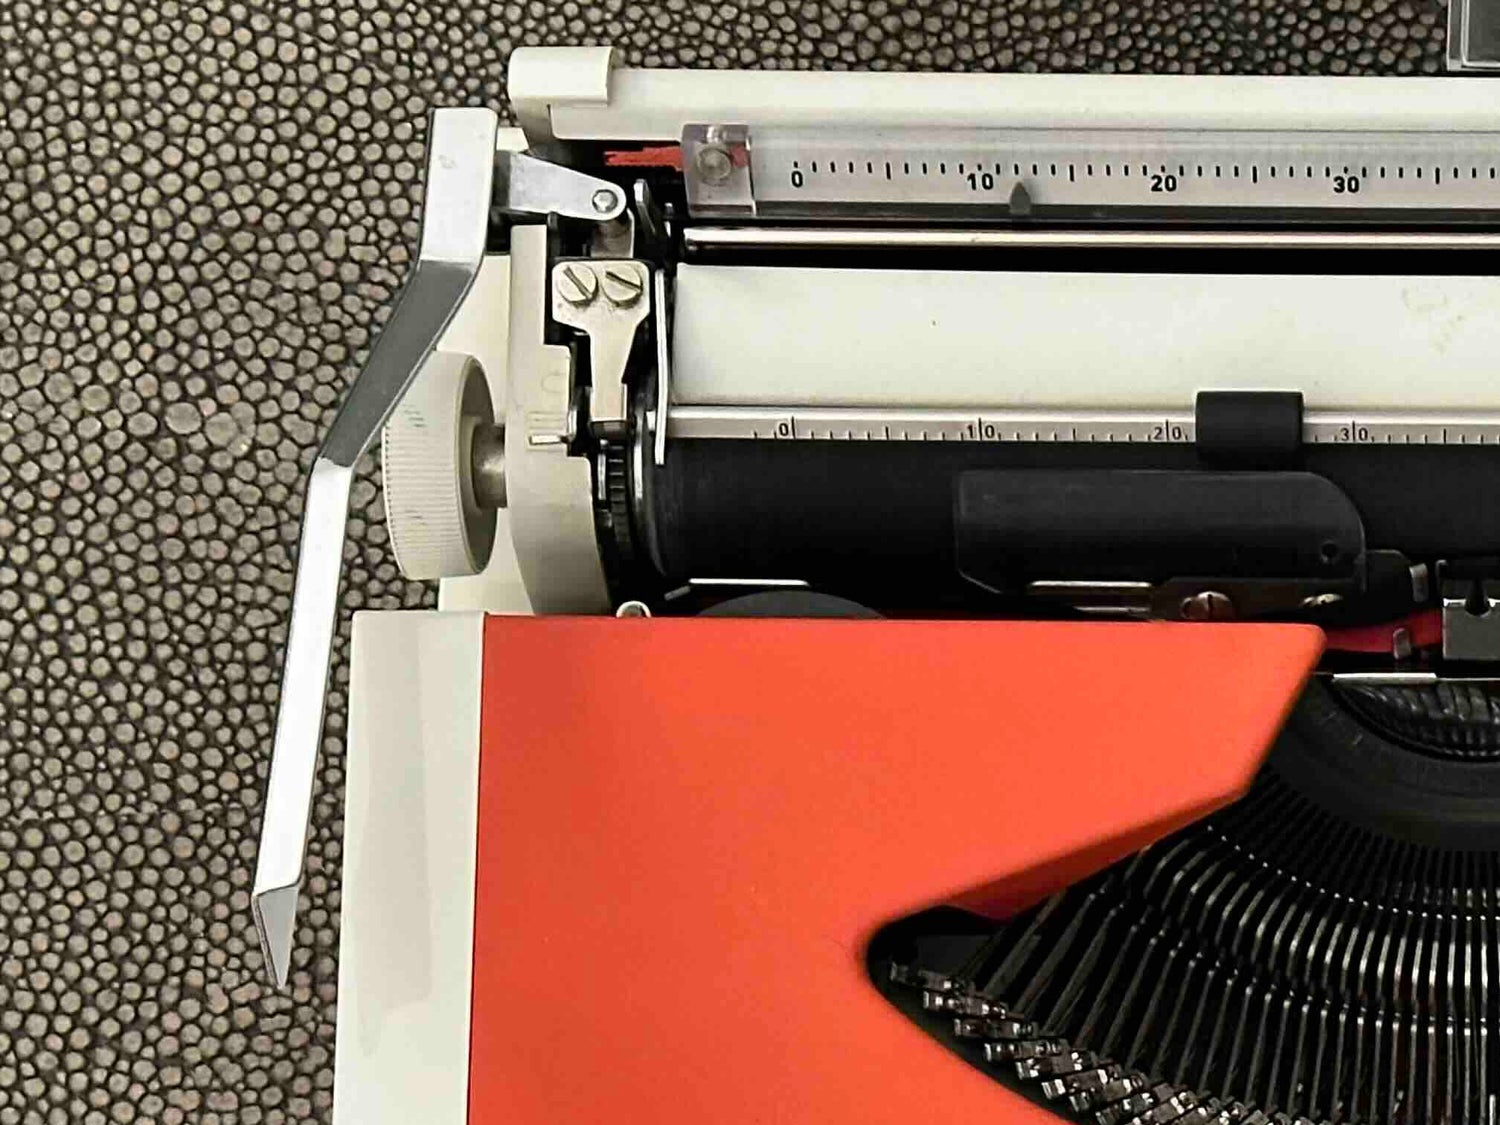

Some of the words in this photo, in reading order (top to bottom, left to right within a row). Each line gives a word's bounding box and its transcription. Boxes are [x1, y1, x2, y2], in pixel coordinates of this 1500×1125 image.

[791, 170, 804, 189] 0
[966, 172, 994, 191] 10
[1150, 174, 1177, 193] 20
[1333, 175, 1360, 194] 30
